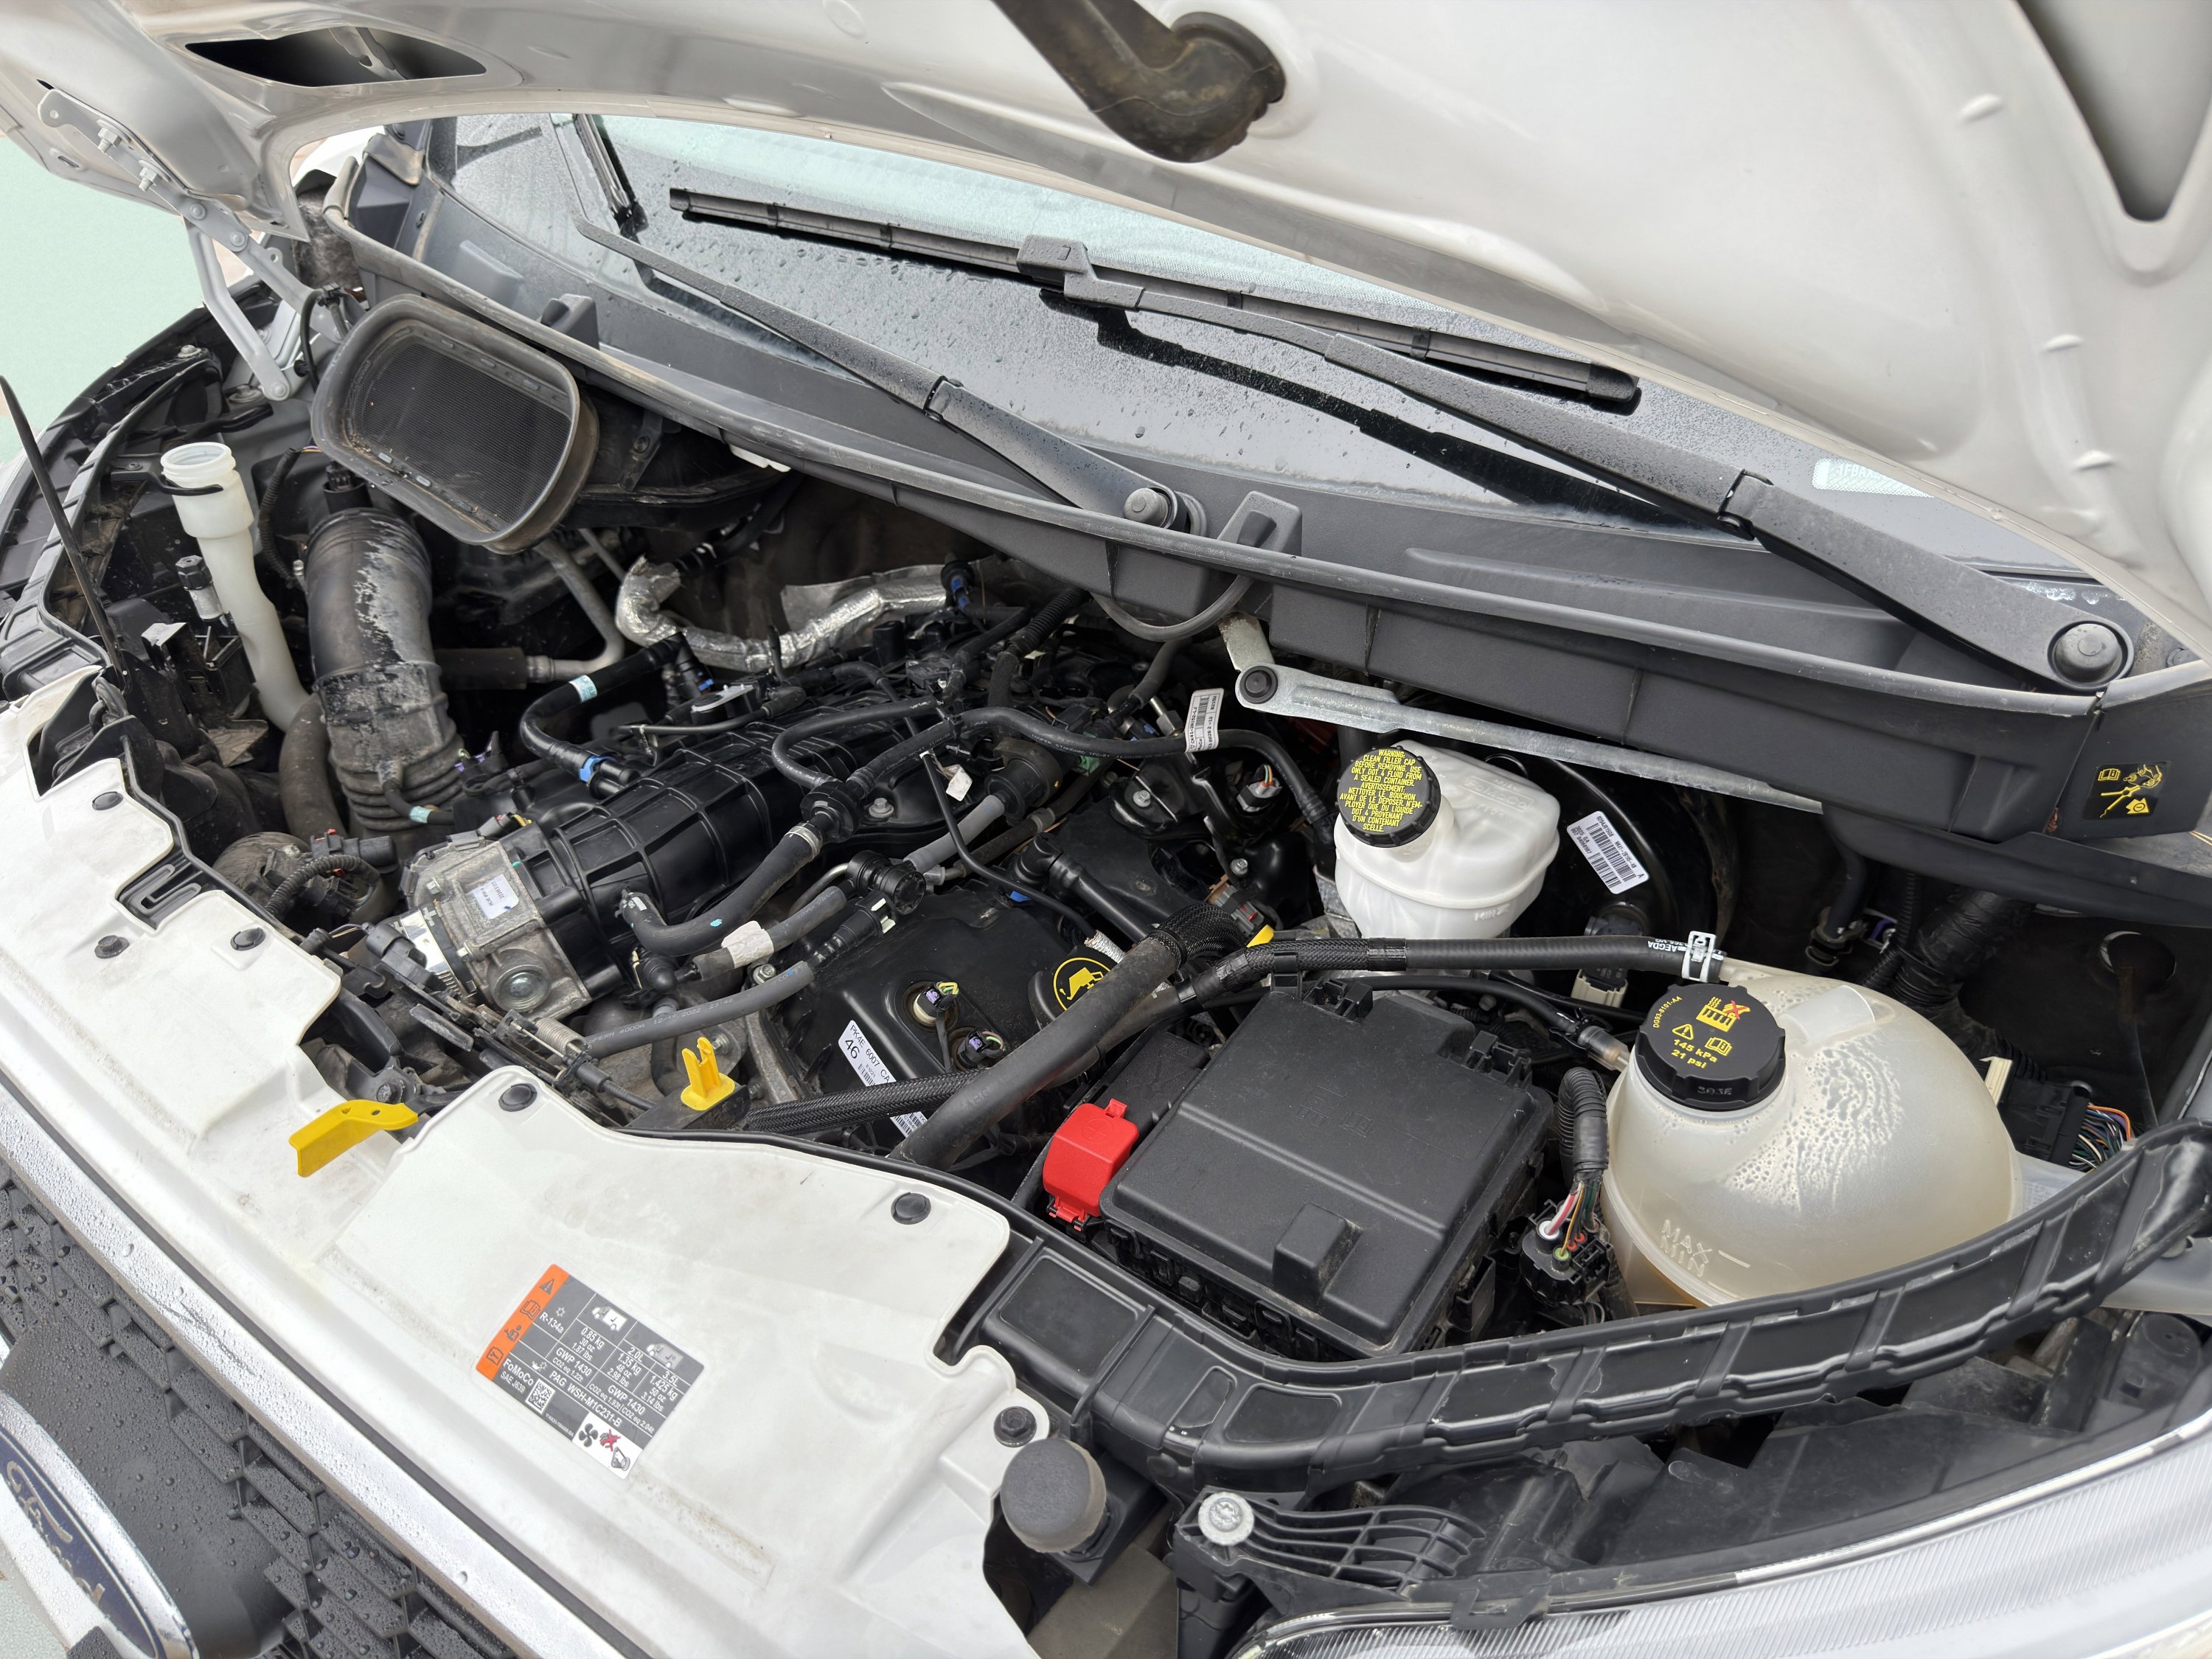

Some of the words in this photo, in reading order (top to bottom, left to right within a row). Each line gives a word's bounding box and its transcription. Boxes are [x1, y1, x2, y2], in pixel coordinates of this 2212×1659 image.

[1363, 754, 1382, 763] CLEAN
[1383, 757, 1402, 765] FILLER
[1378, 749, 1405, 759] WARNING:
[1354, 760, 1376, 769] BEFORE
[1377, 762, 1407, 773] REMOVING.
[1387, 771, 1403, 779] FLUID
[1405, 773, 1422, 781] FROM
[1360, 782, 1405, 793] AVERTISSEMENT:
[1361, 775, 1381, 783] SEALED
[1384, 777, 1415, 787] CONTAINER.
[1340, 793, 1357, 801] AVANT
[1349, 787, 1376, 796] NETTOYER
[1389, 792, 1416, 801] BOUCHON
[1345, 800, 1366, 809] PLOYER
[1391, 806, 1414, 815] LIQUIDE
[1371, 810, 1404, 821] PROVENANT
[1352, 815, 1366, 823] D'UN
[1368, 817, 1400, 827] CONTENANT
[1647, 940, 1679, 953] AEGDA
[1653, 995, 1683, 1029] DG93-8101-AA
[845, 1040, 860, 1060] 46
[849, 1024, 866, 1048] PK4E
[866, 1048, 880, 1067] 6007
[1674, 1039, 1695, 1052] 145
[1695, 1048, 1718, 1063] kPa
[1671, 1049, 1687, 1060] 21
[1687, 1057, 1708, 1069] psi
[1661, 1219, 1713, 1264] MAX
[1660, 1234, 1705, 1277] MIN
[539, 1312, 564, 1333] R-134a
[580, 1338, 588, 1346] 30
[587, 1343, 595, 1352] oz
[581, 1327, 596, 1341] 0.85
[594, 1337, 605, 1349] kg
[571, 1343, 585, 1356] 1.87
[582, 1349, 593, 1361] lbs
[627, 1347, 644, 1363] 2.0L
[503, 1358, 535, 1386] FoMoCo
[553, 1357, 564, 1369] CO2
[563, 1367, 570, 1375] eq
[571, 1370, 583, 1382] 1.22t
[556, 1348, 575, 1363] GWP
[574, 1360, 592, 1377] 1430
[616, 1364, 624, 1372] 48
[624, 1370, 632, 1378] oz
[618, 1353, 633, 1367] 1.35
[630, 1362, 641, 1376] kg
[501, 1371, 512, 1384] SAE
[511, 1380, 526, 1393] J639
[607, 1368, 621, 1381] 2.98
[619, 1377, 630, 1387] lbs
[663, 1371, 678, 1387] 3.5L
[589, 1383, 601, 1396] CO2
[600, 1392, 608, 1401] eq
[649, 1375, 669, 1392] 1.425
[667, 1388, 678, 1401] kg
[650, 1387, 658, 1397] 50
[657, 1393, 667, 1401] oz
[549, 1371, 566, 1386] PAG
[567, 1383, 622, 1427] WSH-M1C231-B
[608, 1385, 628, 1401] GWP
[627, 1398, 645, 1415] 1430
[641, 1391, 654, 1405] 3.14
[653, 1401, 664, 1411] lbs
[622, 1406, 634, 1418] CO2
[633, 1416, 640, 1425] eq
[640, 1420, 655, 1433] 2.04t
